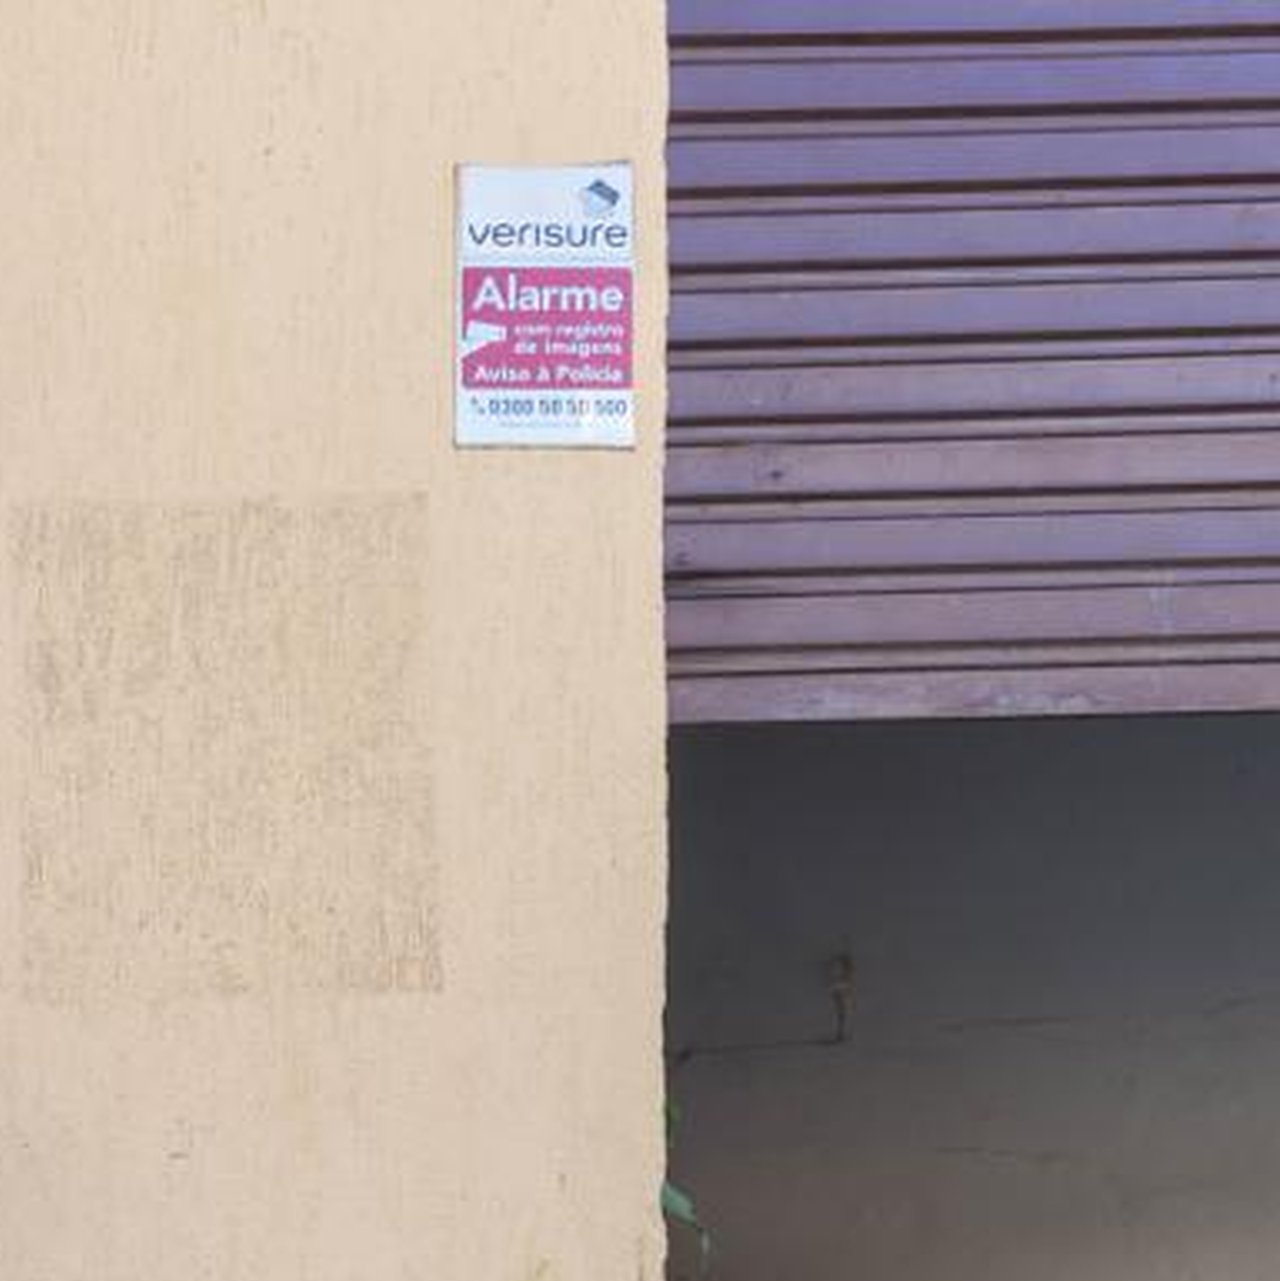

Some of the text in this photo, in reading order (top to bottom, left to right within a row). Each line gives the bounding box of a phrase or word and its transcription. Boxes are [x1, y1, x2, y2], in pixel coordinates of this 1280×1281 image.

[468, 222, 628, 247] verisure
[472, 273, 624, 312] Alarme
[514, 338, 623, 357] de imagens
[474, 365, 531, 382] Aviso
